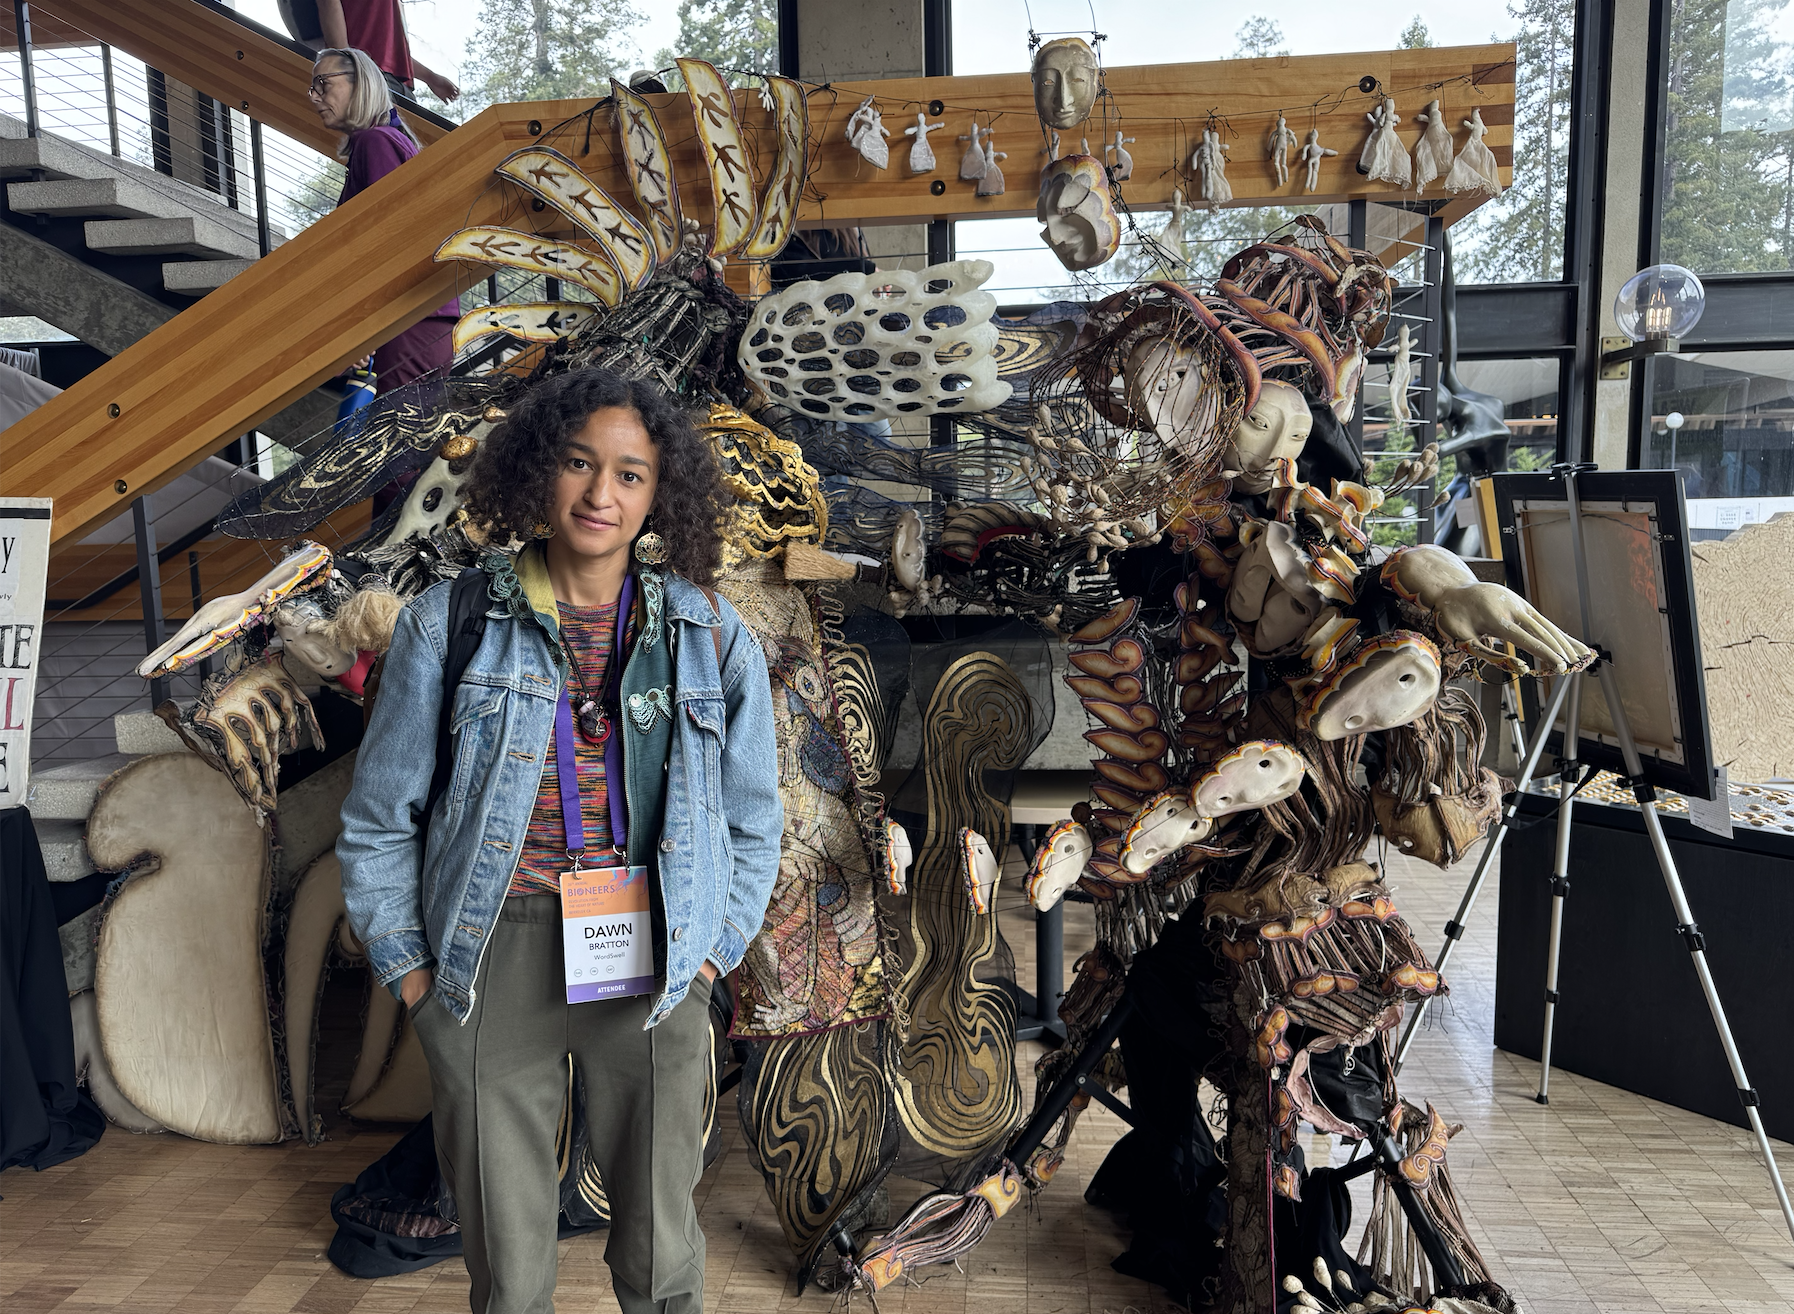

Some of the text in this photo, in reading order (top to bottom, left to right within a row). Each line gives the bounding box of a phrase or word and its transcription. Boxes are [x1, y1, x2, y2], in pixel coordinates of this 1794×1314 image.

[567, 885, 615, 897] BIONEERS
[584, 922, 633, 939] DAWN
[589, 939, 629, 951] BRATTON
[593, 951, 626, 960] WordSwell
[597, 984, 626, 994] ATTENDEE
